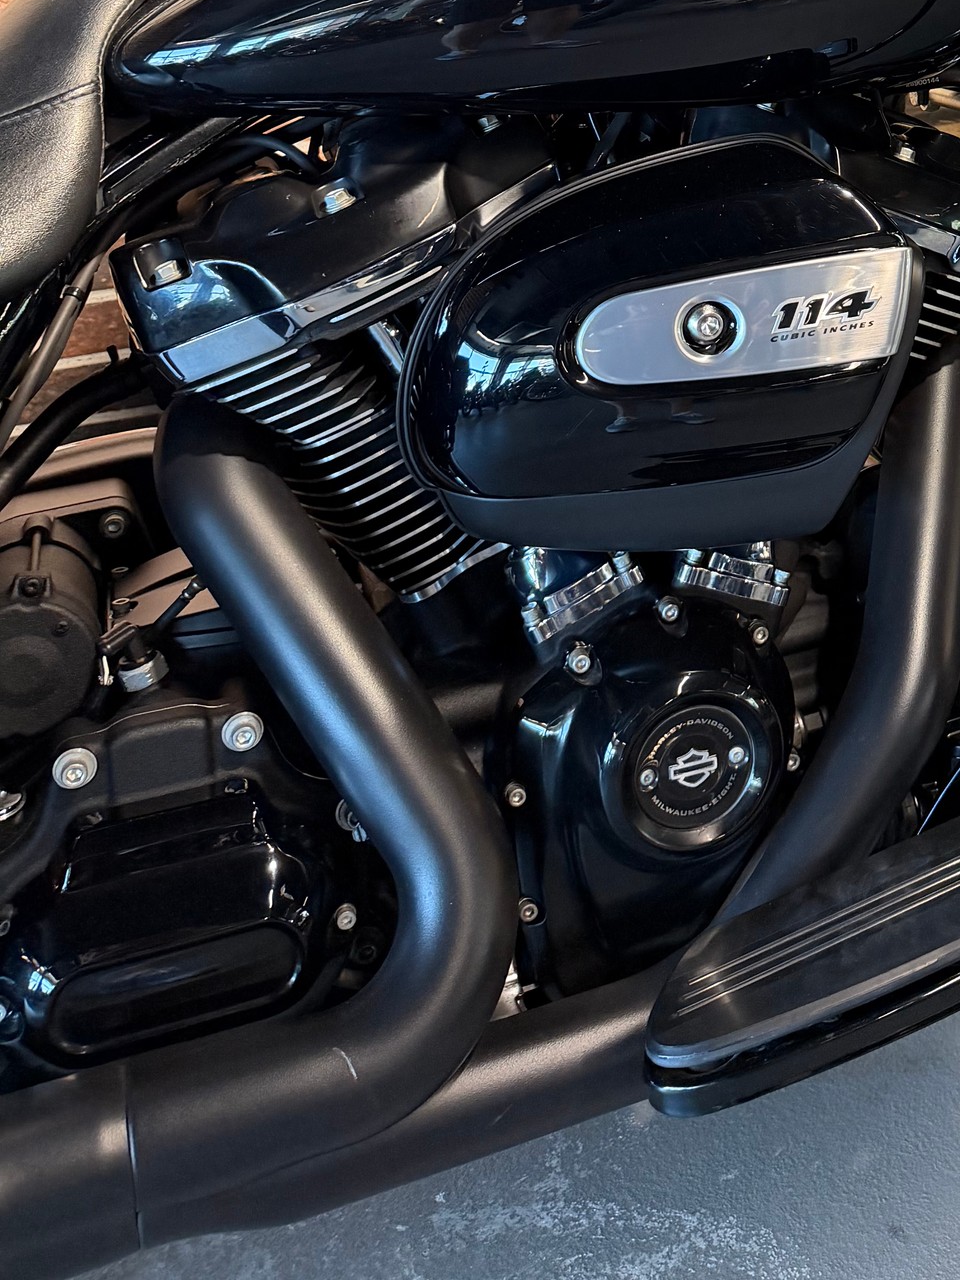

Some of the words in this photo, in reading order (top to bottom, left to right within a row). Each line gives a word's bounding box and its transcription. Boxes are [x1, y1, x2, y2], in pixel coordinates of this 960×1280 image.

[771, 284, 882, 335] 114
[770, 329, 817, 343] CUBIC
[823, 320, 875, 335] INCHES
[647, 717, 734, 760] HARLEY-DAVIDSON
